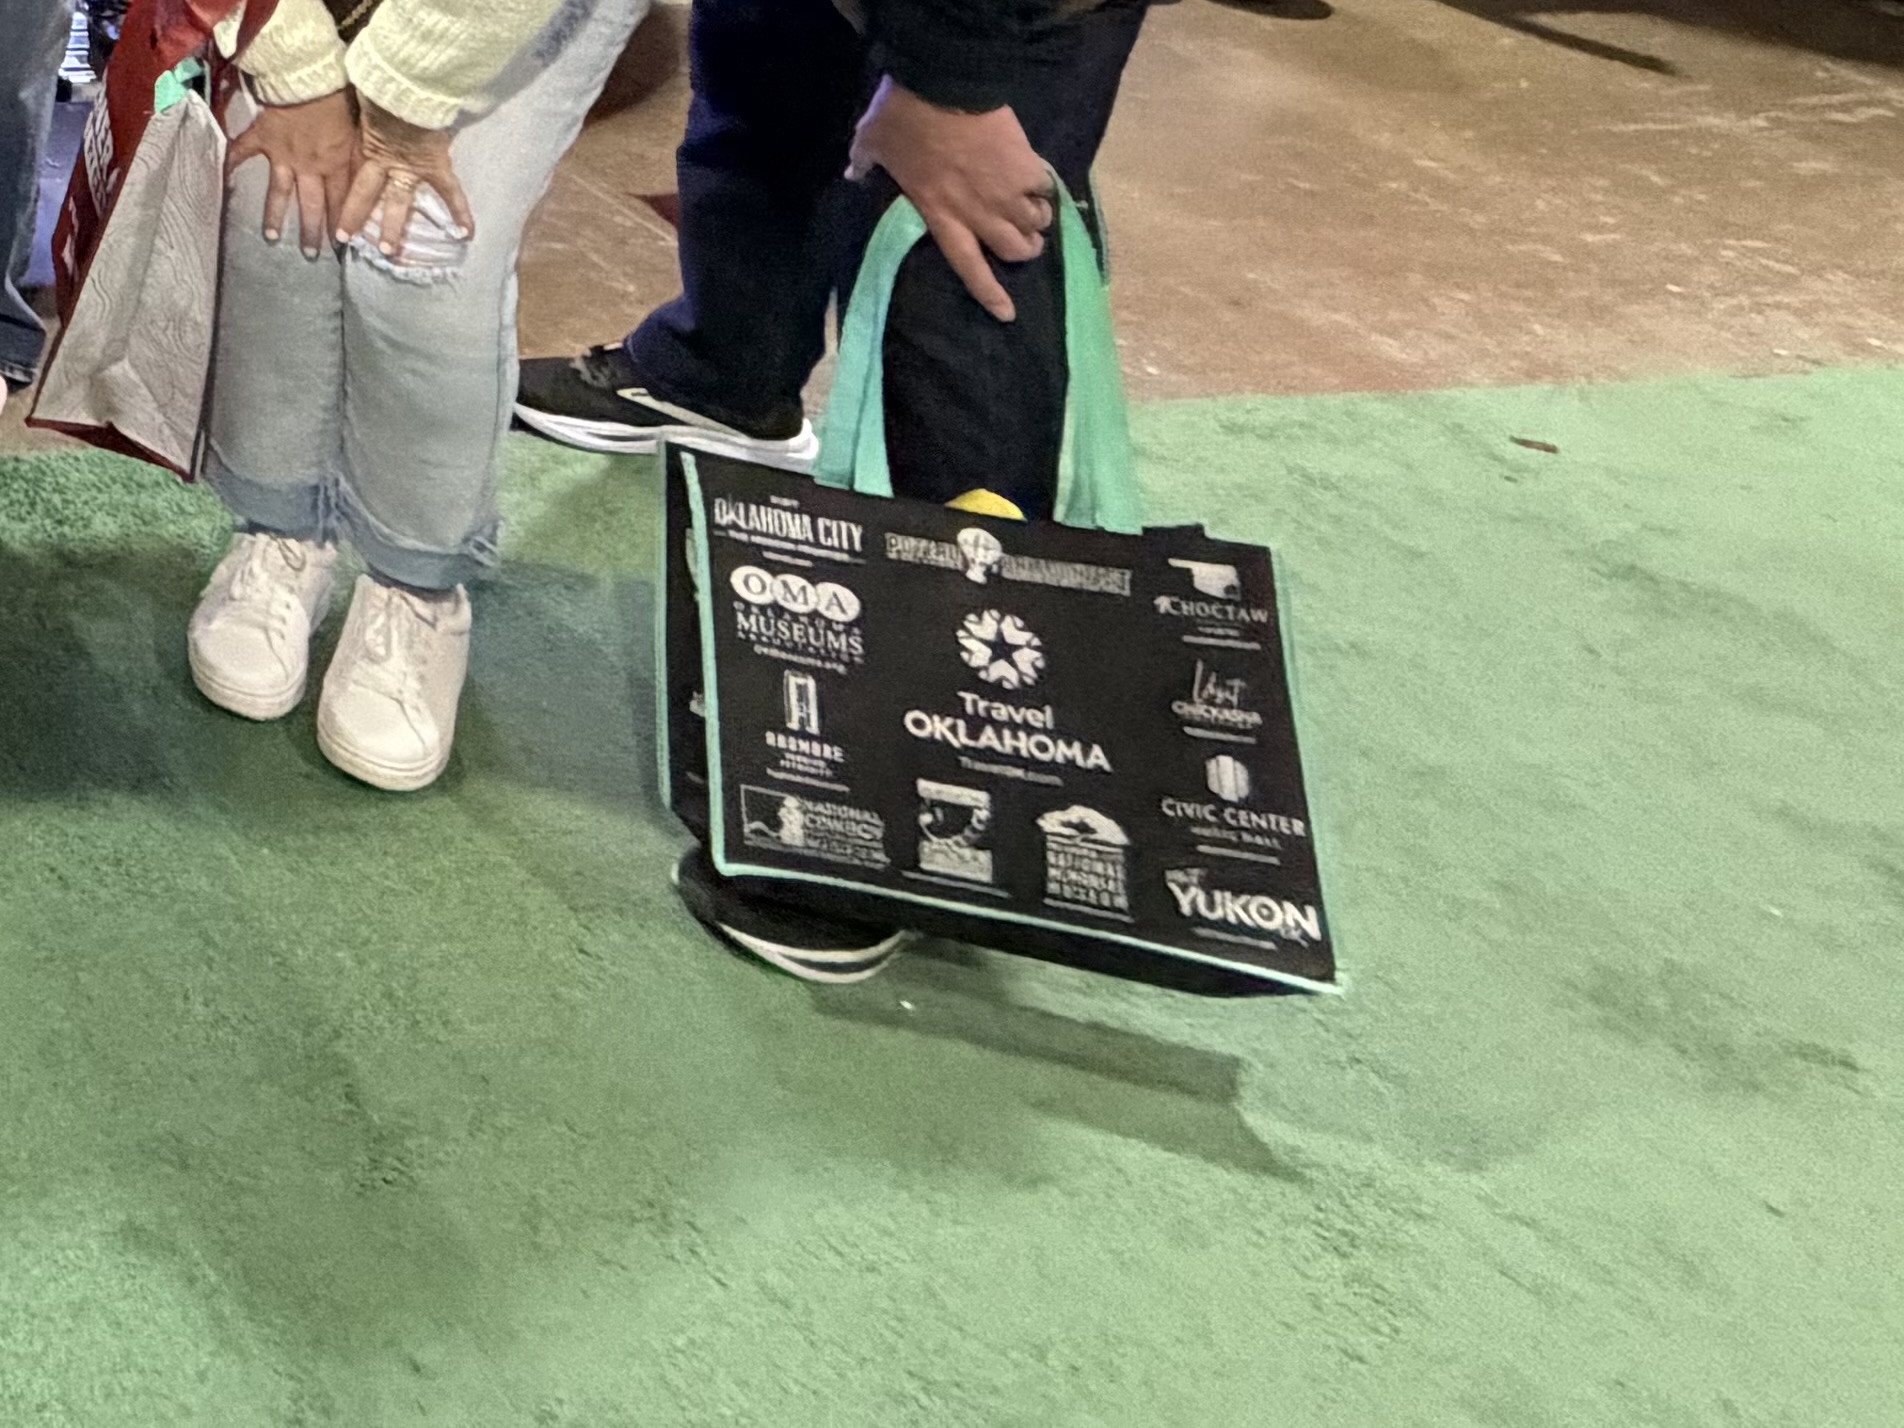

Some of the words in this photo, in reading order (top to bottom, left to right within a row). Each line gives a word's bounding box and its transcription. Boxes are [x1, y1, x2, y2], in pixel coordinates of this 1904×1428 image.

[714, 496, 815, 543] OKLAHOMA
[817, 517, 863, 552] CITY
[742, 572, 850, 617] OMA
[1169, 597, 1269, 624] CHOCTAW
[736, 611, 864, 656] MUSEUMS
[957, 691, 1054, 729] Travel
[903, 709, 1113, 773] OKLAHOMA
[1161, 797, 1218, 823] CIVIC
[1223, 806, 1307, 837] CENTER
[1166, 881, 1323, 941] YUKON
